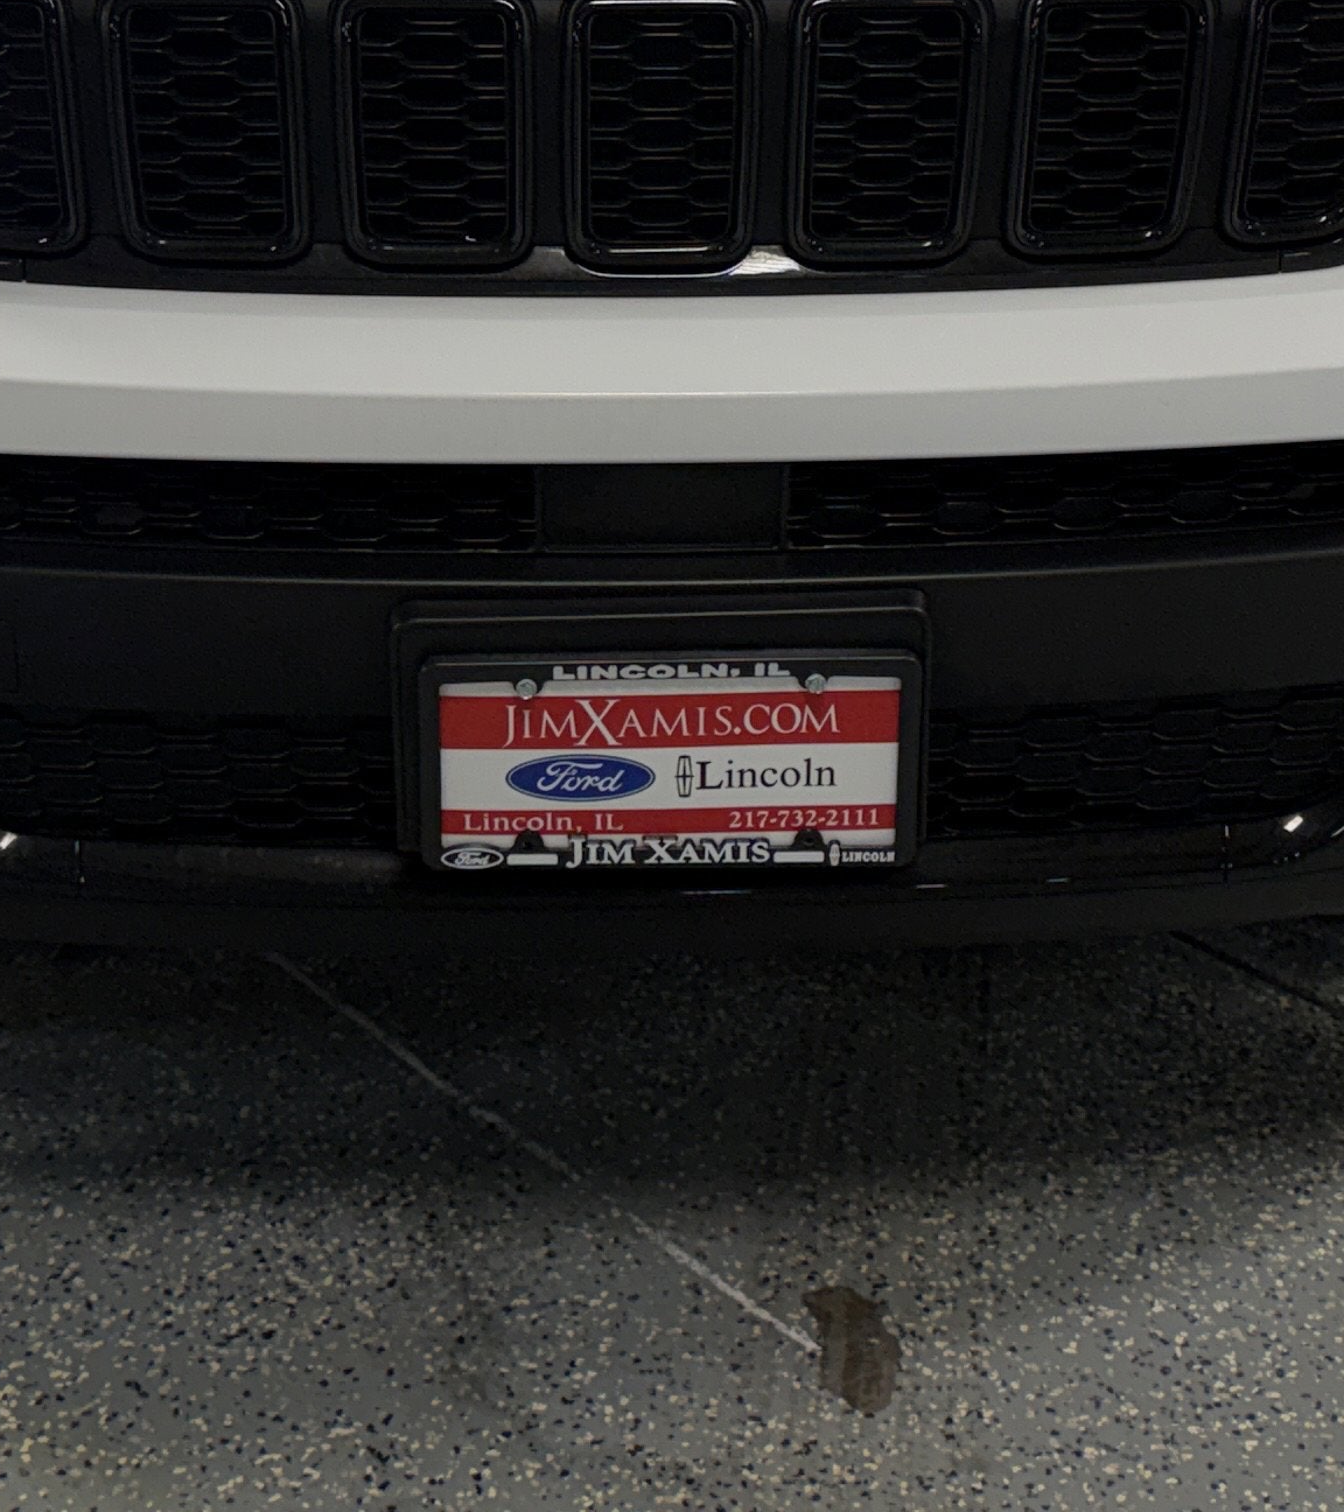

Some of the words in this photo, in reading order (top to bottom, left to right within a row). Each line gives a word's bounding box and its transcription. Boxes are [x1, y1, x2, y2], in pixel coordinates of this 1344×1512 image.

[553, 663, 740, 680] LINCOLN,
[754, 662, 790, 677] IL
[537, 761, 626, 795] Ford
[696, 758, 836, 790] Lincoln
[464, 813, 582, 833] Lincoln,
[595, 813, 624, 831] IL
[729, 808, 879, 828] 217-732-2111
[566, 836, 635, 868] JIM
[644, 838, 771, 864] XAMIS
[842, 851, 895, 863] LINCOLN
